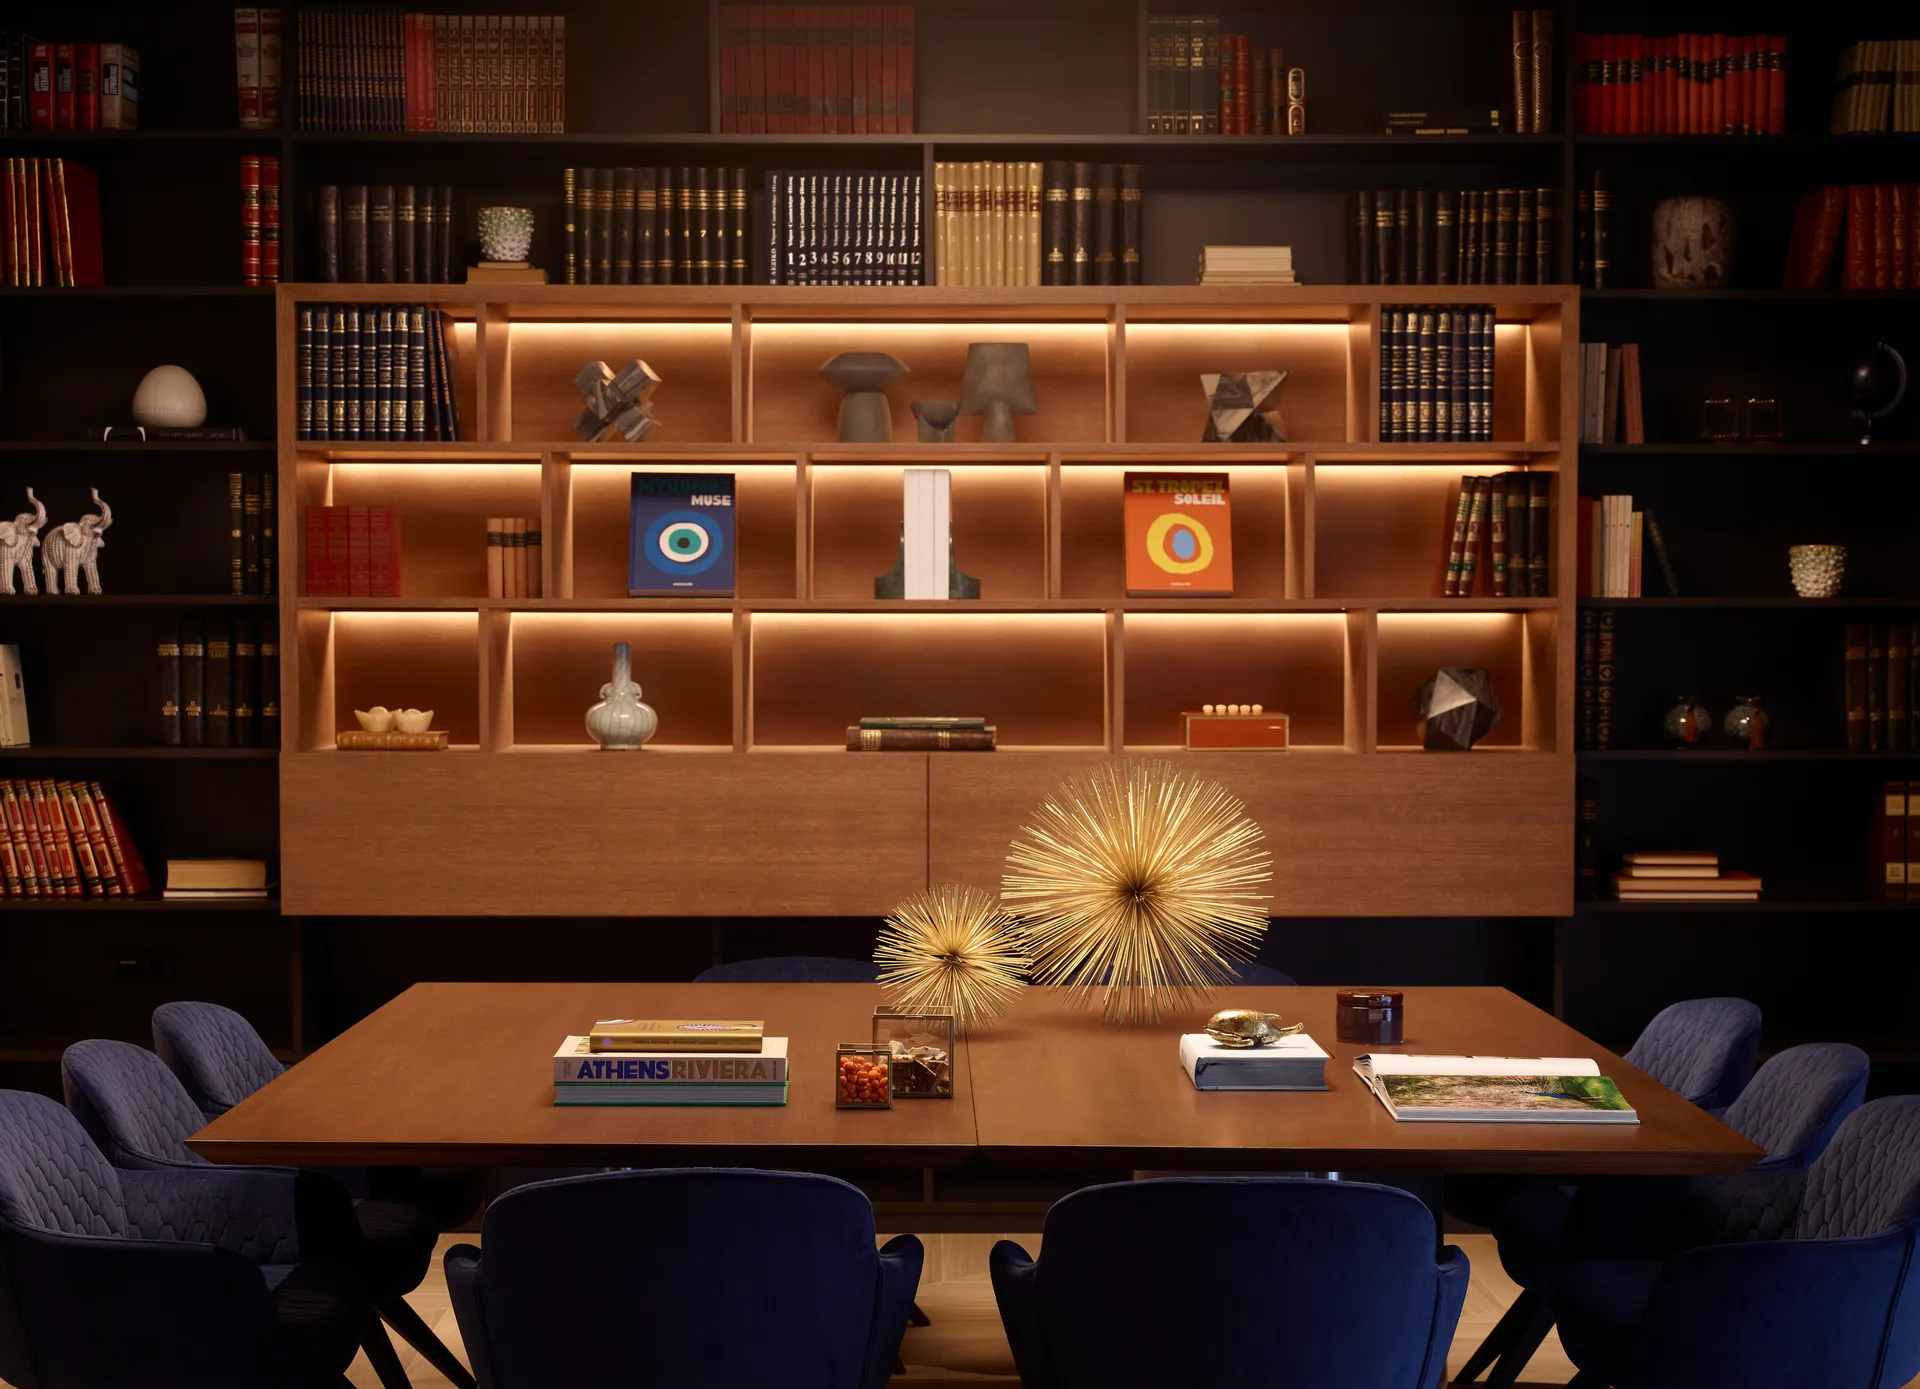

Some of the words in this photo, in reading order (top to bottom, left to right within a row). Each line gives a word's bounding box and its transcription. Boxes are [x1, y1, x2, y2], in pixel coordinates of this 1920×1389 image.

[788, 252, 794, 265] 1
[799, 253, 807, 266] 2
[809, 251, 818, 264] 3
[820, 252, 828, 264] 4
[831, 251, 840, 264] 5
[842, 252, 850, 265] 6
[854, 252, 862, 264] 7
[865, 251, 873, 264] 8
[876, 251, 884, 264] 9
[886, 252, 896, 265] 10
[898, 252, 908, 265] 11
[911, 252, 921, 265] 12
[1156, 479, 1226, 494] TROPEZ
[691, 494, 731, 506] MUSE
[1174, 493, 1226, 505] SOLEIL
[577, 1060, 669, 1080] ATHENS
[671, 1060, 767, 1080] RIVIERA
